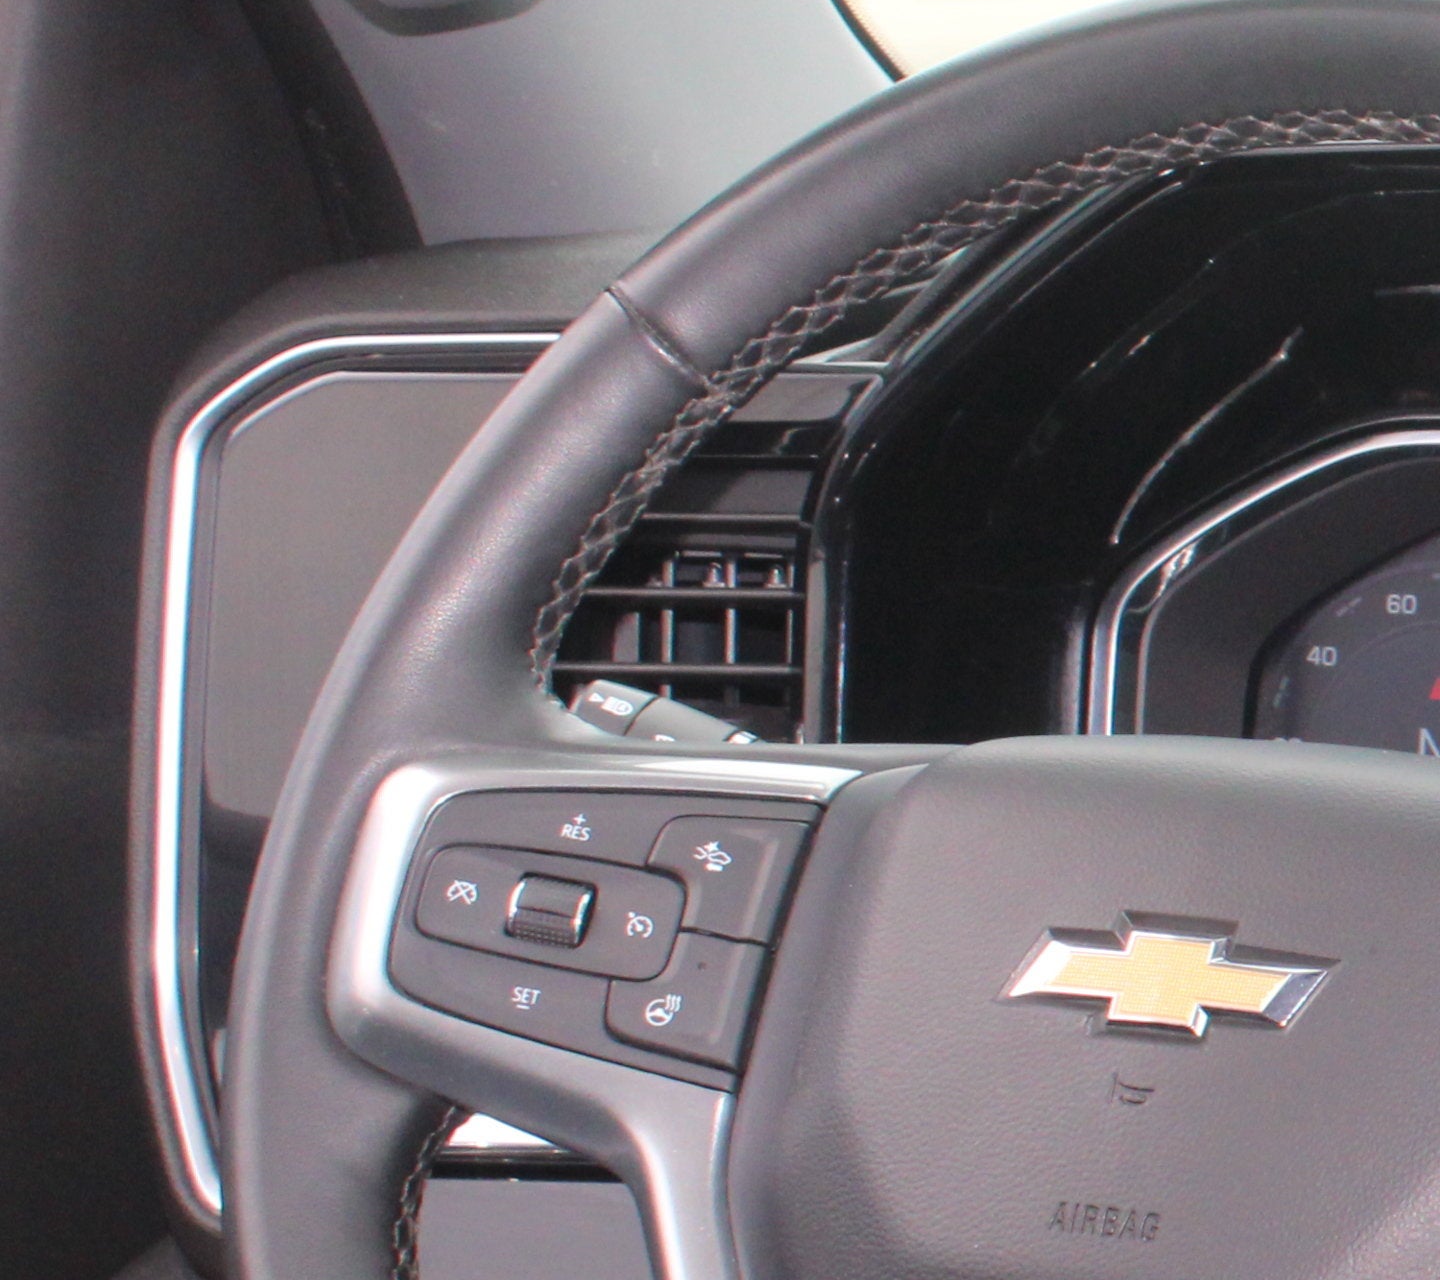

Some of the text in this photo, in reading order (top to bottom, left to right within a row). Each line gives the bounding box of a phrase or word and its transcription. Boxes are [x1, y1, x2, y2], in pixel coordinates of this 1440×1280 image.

[1386, 595, 1417, 615] 60
[1306, 646, 1337, 667] 40
[560, 823, 591, 841] RES
[511, 987, 540, 1005] SET
[1049, 1202, 1161, 1242] AIRBAG
